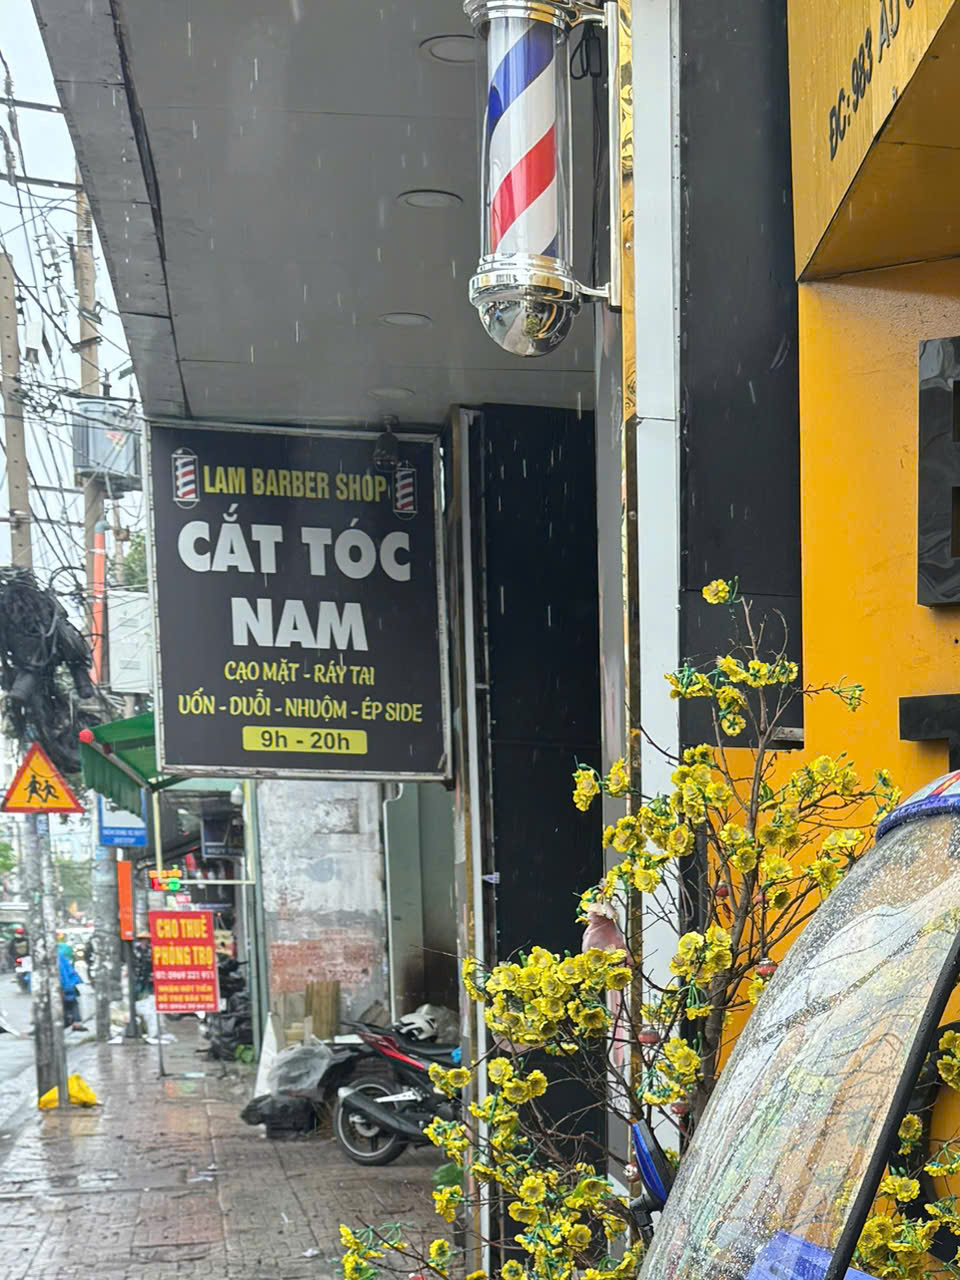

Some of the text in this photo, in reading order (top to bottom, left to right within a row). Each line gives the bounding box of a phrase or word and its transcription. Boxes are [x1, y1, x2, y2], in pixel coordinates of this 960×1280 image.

[852, 27, 873, 114] 983
[204, 465, 388, 502] LAM BARBER SHOP
[178, 503, 411, 582] CẮT TÓC
[231, 597, 369, 651] NAM
[224, 661, 259, 683] CẠO
[263, 657, 299, 684] MẶT
[314, 661, 347, 684] RÁY
[349, 665, 375, 686] TAI
[178, 687, 215, 715] UỐN
[230, 688, 271, 717] DUỖI
[285, 695, 347, 723] NHUỘM
[361, 697, 383, 722] ÉP
[385, 701, 423, 723] SIDE
[260, 731, 288, 749] 9h
[310, 732, 350, 751] 20h
[155, 917, 179, 938] CHO
[153, 941, 191, 967] PHÒNG
